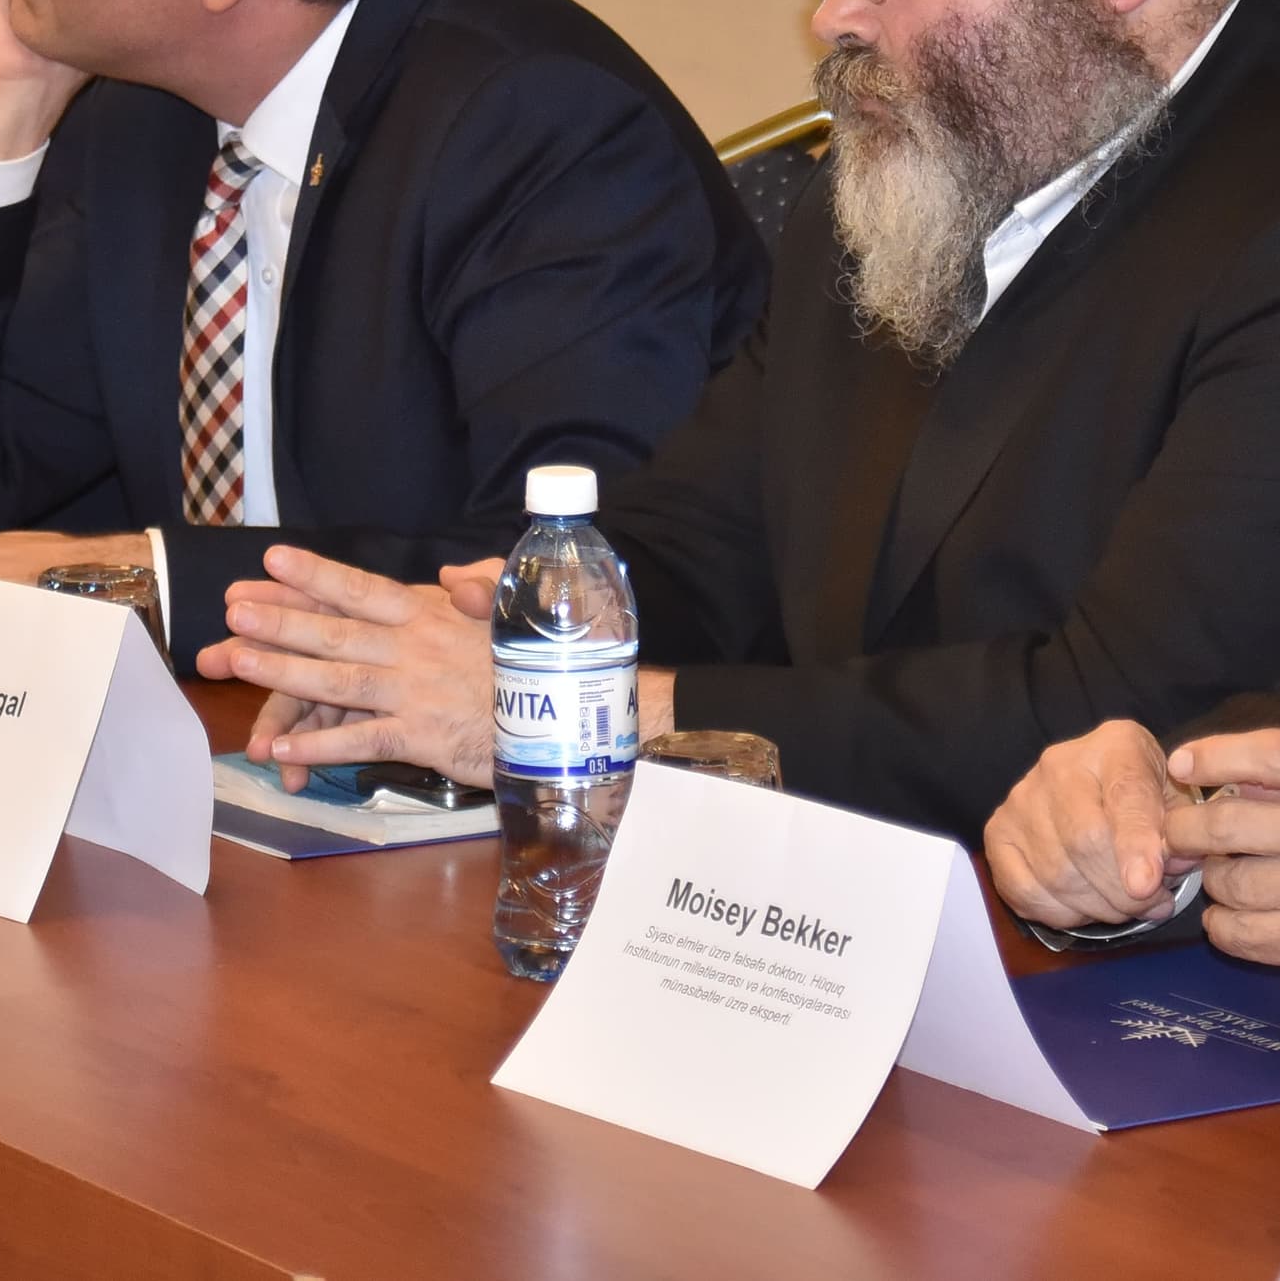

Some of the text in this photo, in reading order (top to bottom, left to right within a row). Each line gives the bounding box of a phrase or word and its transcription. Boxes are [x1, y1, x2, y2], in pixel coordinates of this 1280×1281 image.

[666, 878, 853, 957] Moisey Bekker
[810, 974, 846, 998] Hüquq
[1120, 999, 1181, 1018] Hotel
[1176, 1015, 1225, 1031] Park
[1198, 1010, 1269, 1030] BAKU
